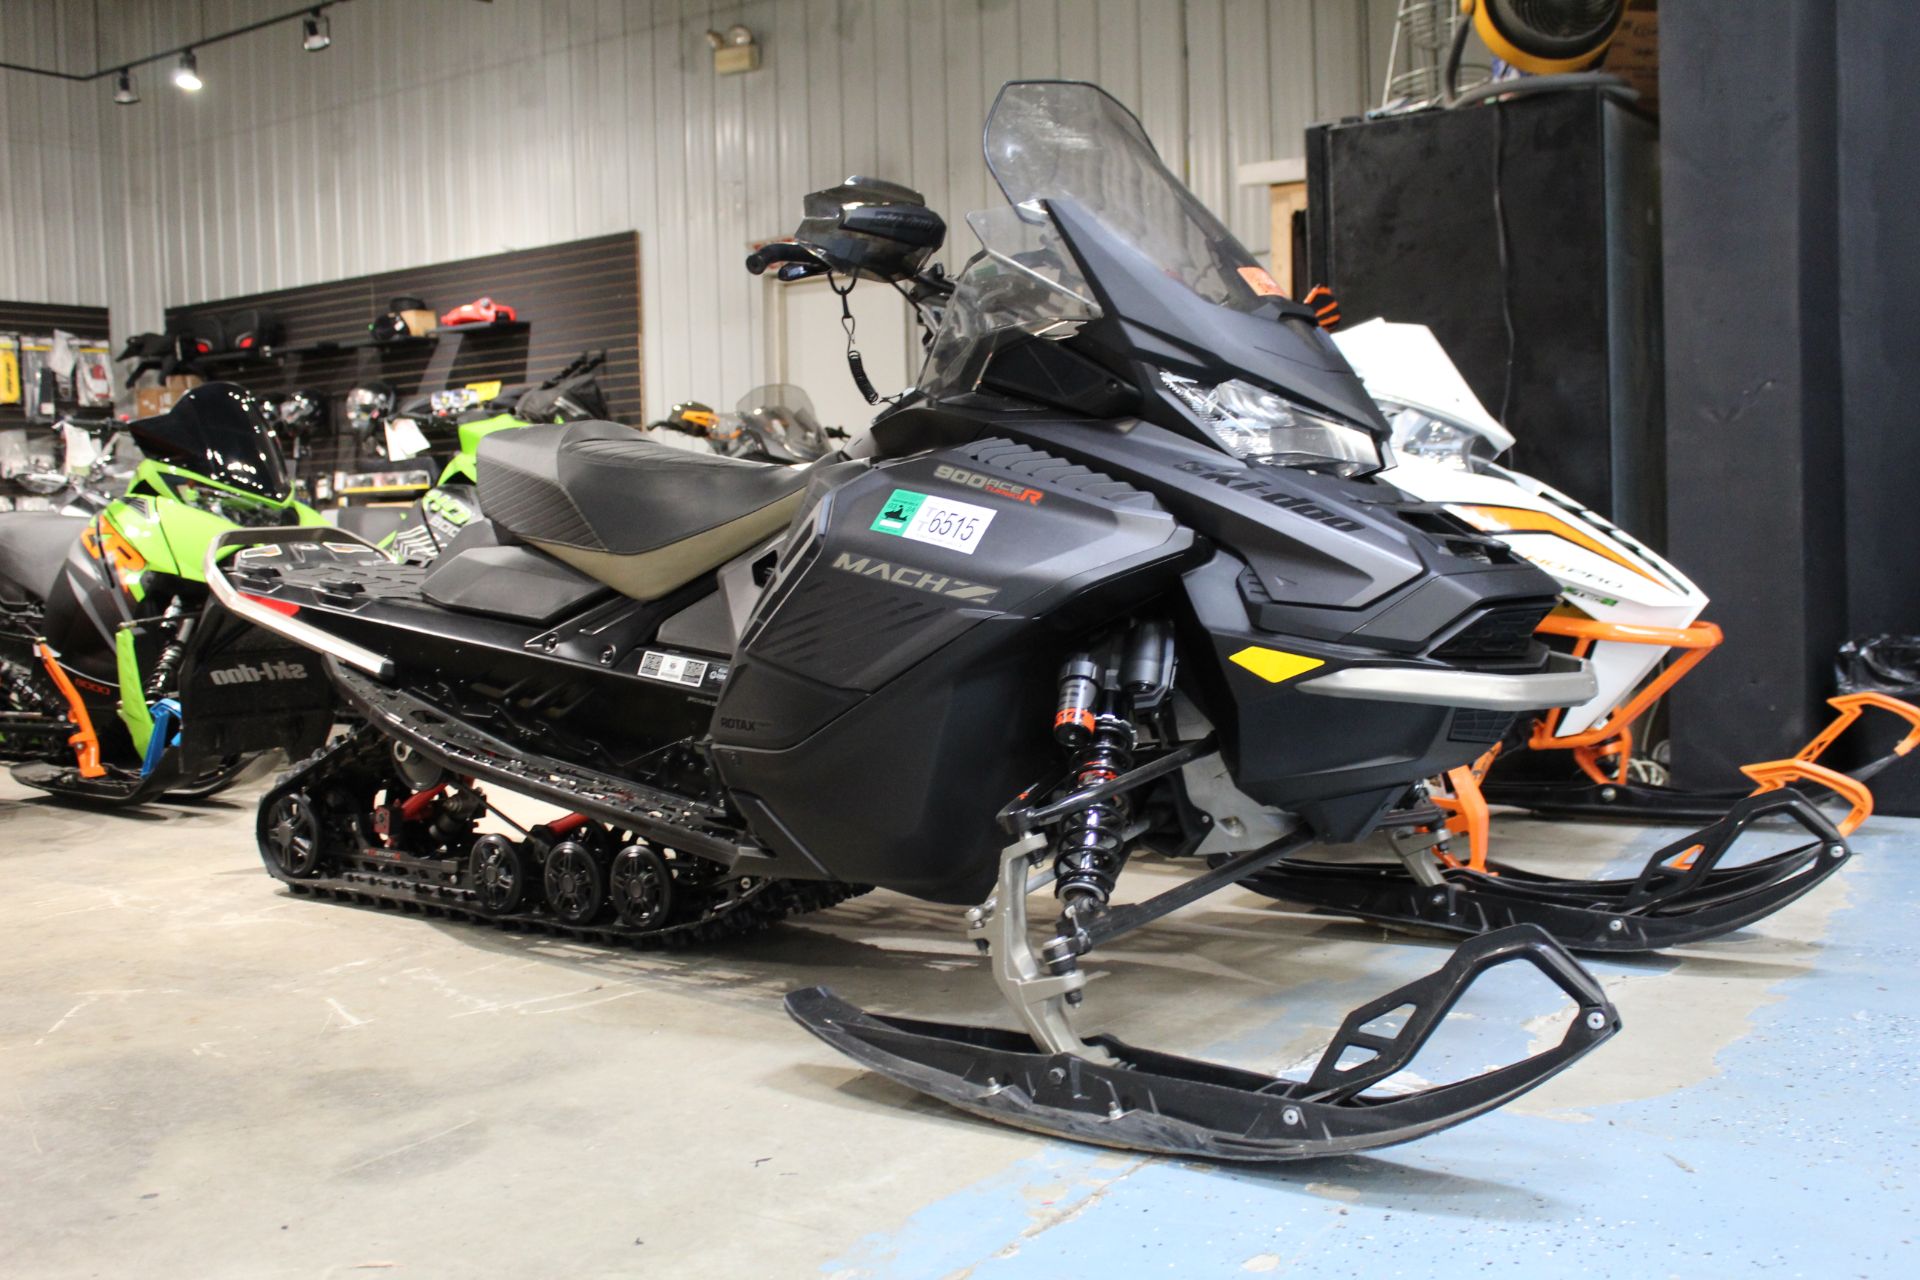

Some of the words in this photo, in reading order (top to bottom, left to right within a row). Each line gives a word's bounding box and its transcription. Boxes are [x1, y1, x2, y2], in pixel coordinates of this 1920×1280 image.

[933, 464, 989, 489] 900
[928, 510, 980, 541] 6515
[720, 717, 756, 731] ROTAX
